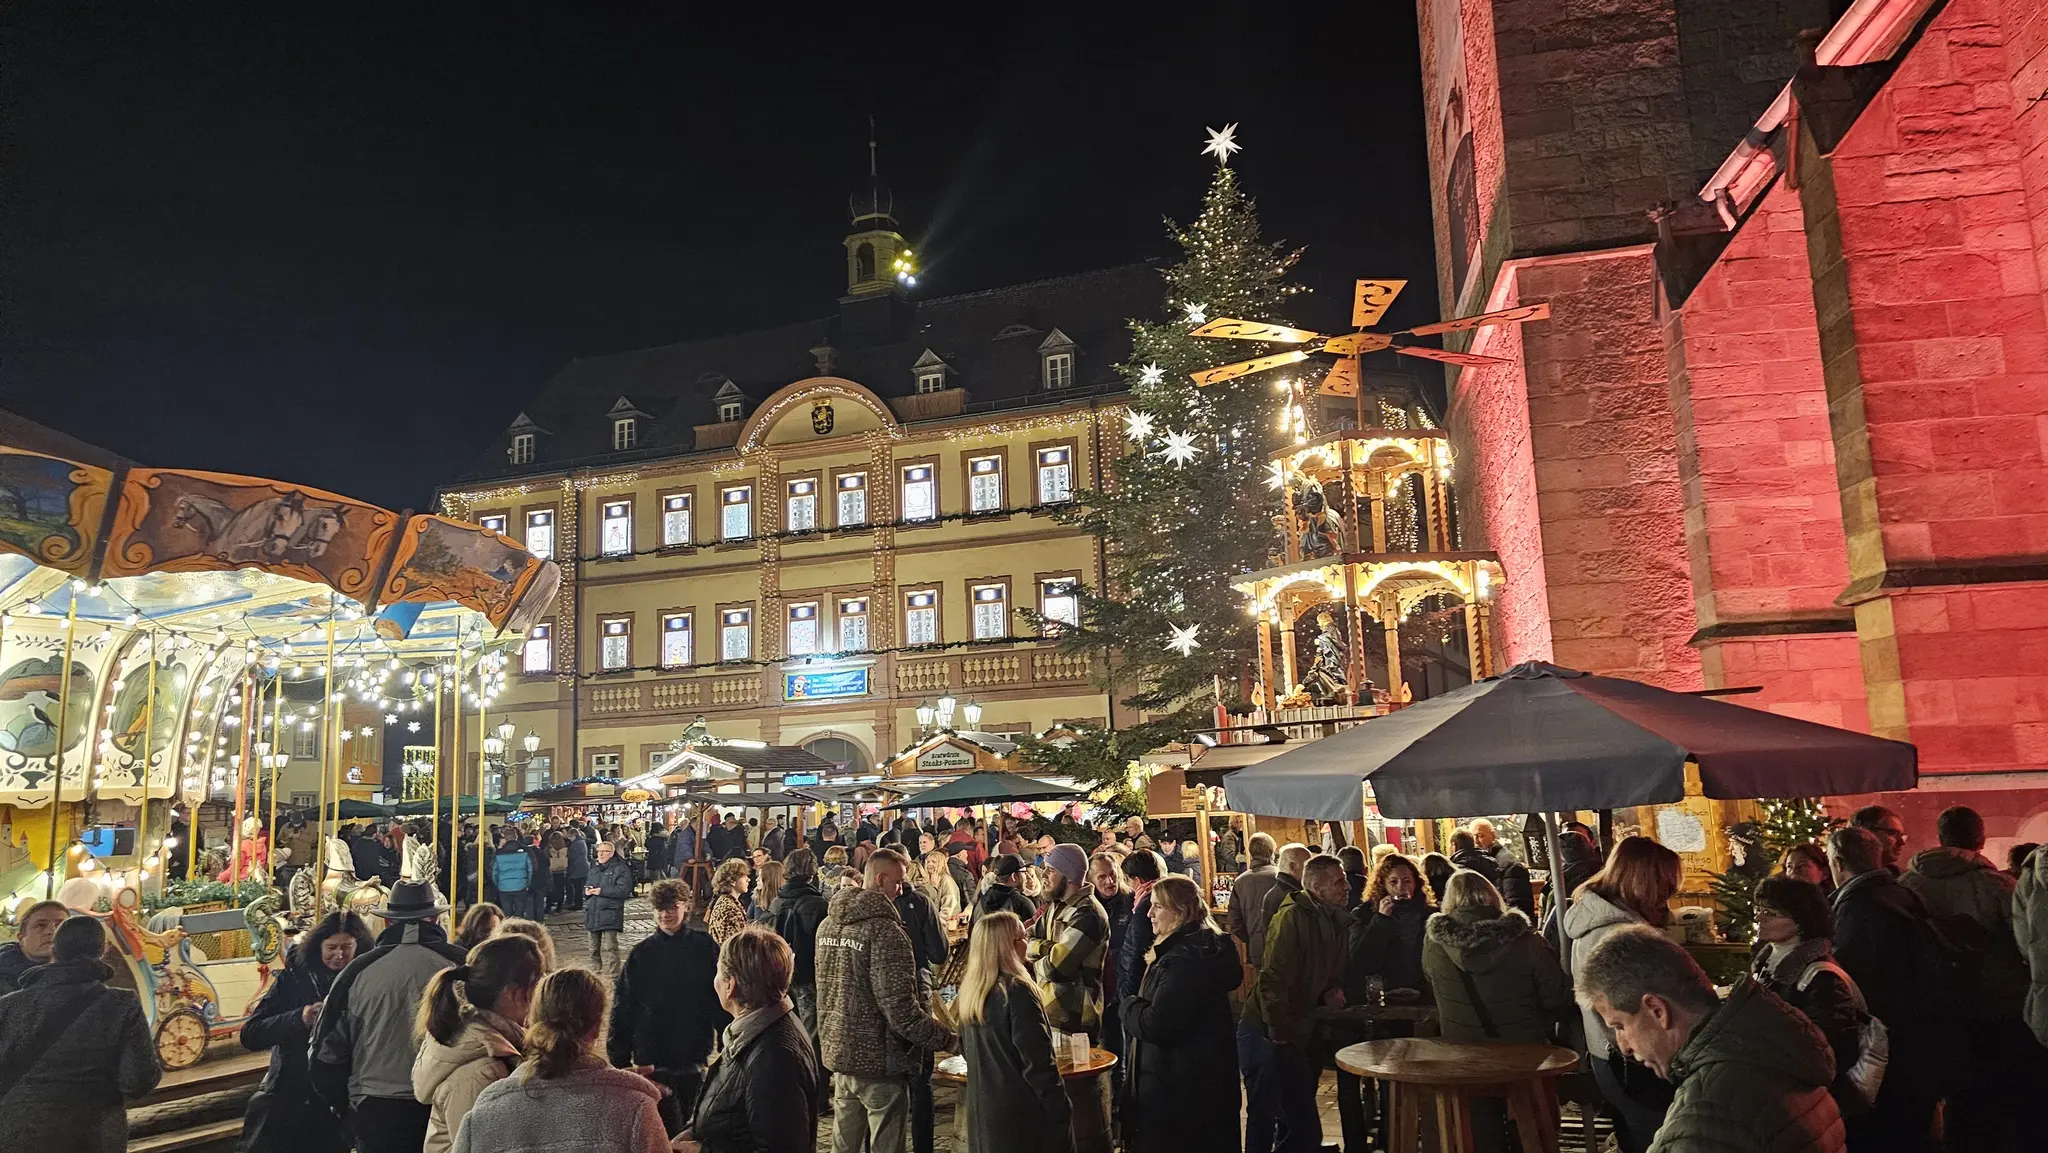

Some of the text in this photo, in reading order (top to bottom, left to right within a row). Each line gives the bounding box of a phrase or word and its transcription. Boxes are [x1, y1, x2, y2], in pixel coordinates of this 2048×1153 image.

[921, 758, 970, 767] Steaks-Pommes
[818, 937, 865, 952] KARL KANI
